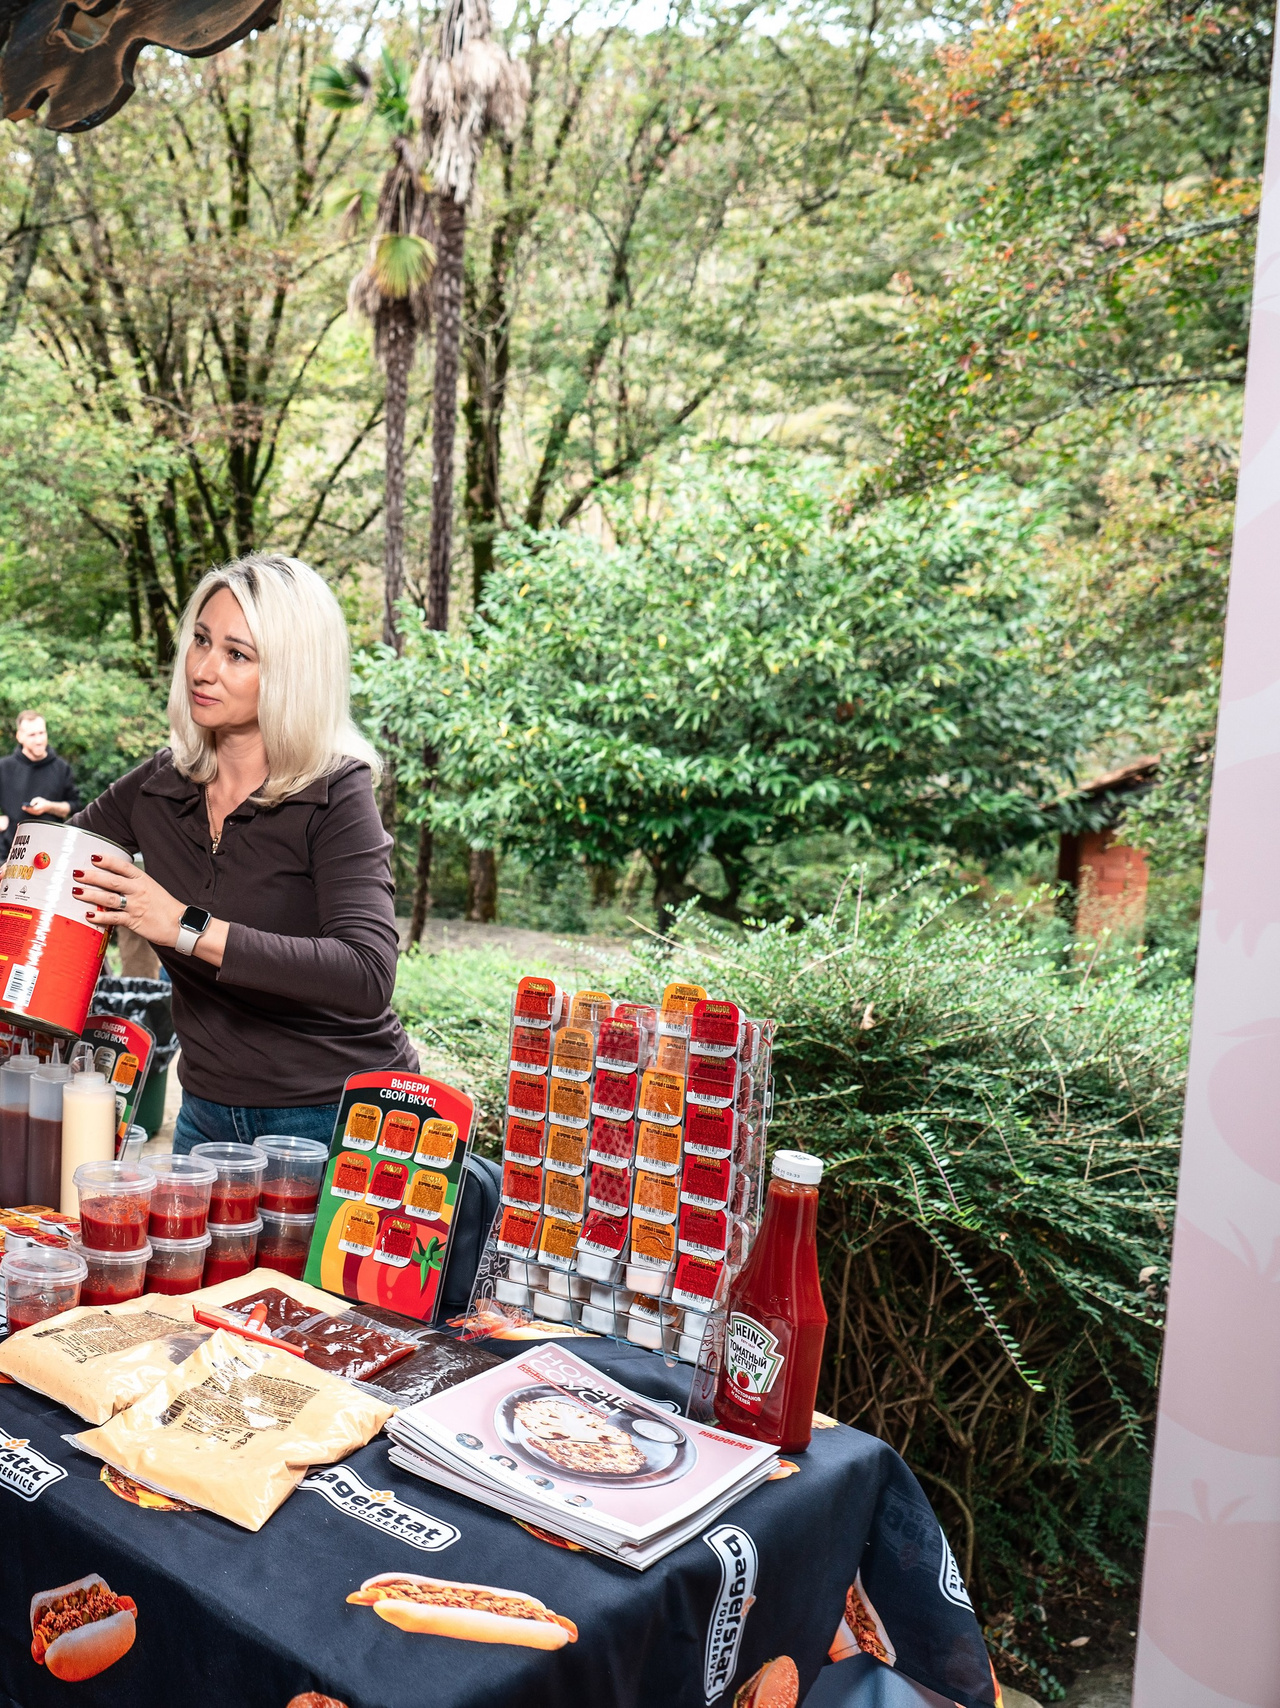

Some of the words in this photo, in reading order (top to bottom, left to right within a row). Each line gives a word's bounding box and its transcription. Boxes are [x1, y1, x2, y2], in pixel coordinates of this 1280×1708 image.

[94, 1030, 110, 1040] СВОЙ
[102, 1021, 126, 1034] ВЫБЕРИ
[379, 1088, 405, 1102] СВОЙ
[407, 1094, 437, 1108] ВКУС!
[390, 1078, 430, 1095] ВЫБЕРИ
[736, 1323, 766, 1350] HEINZ
[730, 1339, 768, 1369] ТОМАТНЫЙ
[734, 1353, 757, 1374] КЕТЧУП
[528, 1358, 622, 1416] СОУСЫ
[540, 1351, 634, 1409] НОВЫЕ
[734, 1442, 754, 1451] PRO
[342, 1501, 430, 1546] FOODSERVICE
[714, 1534, 747, 1688] bagerstat
